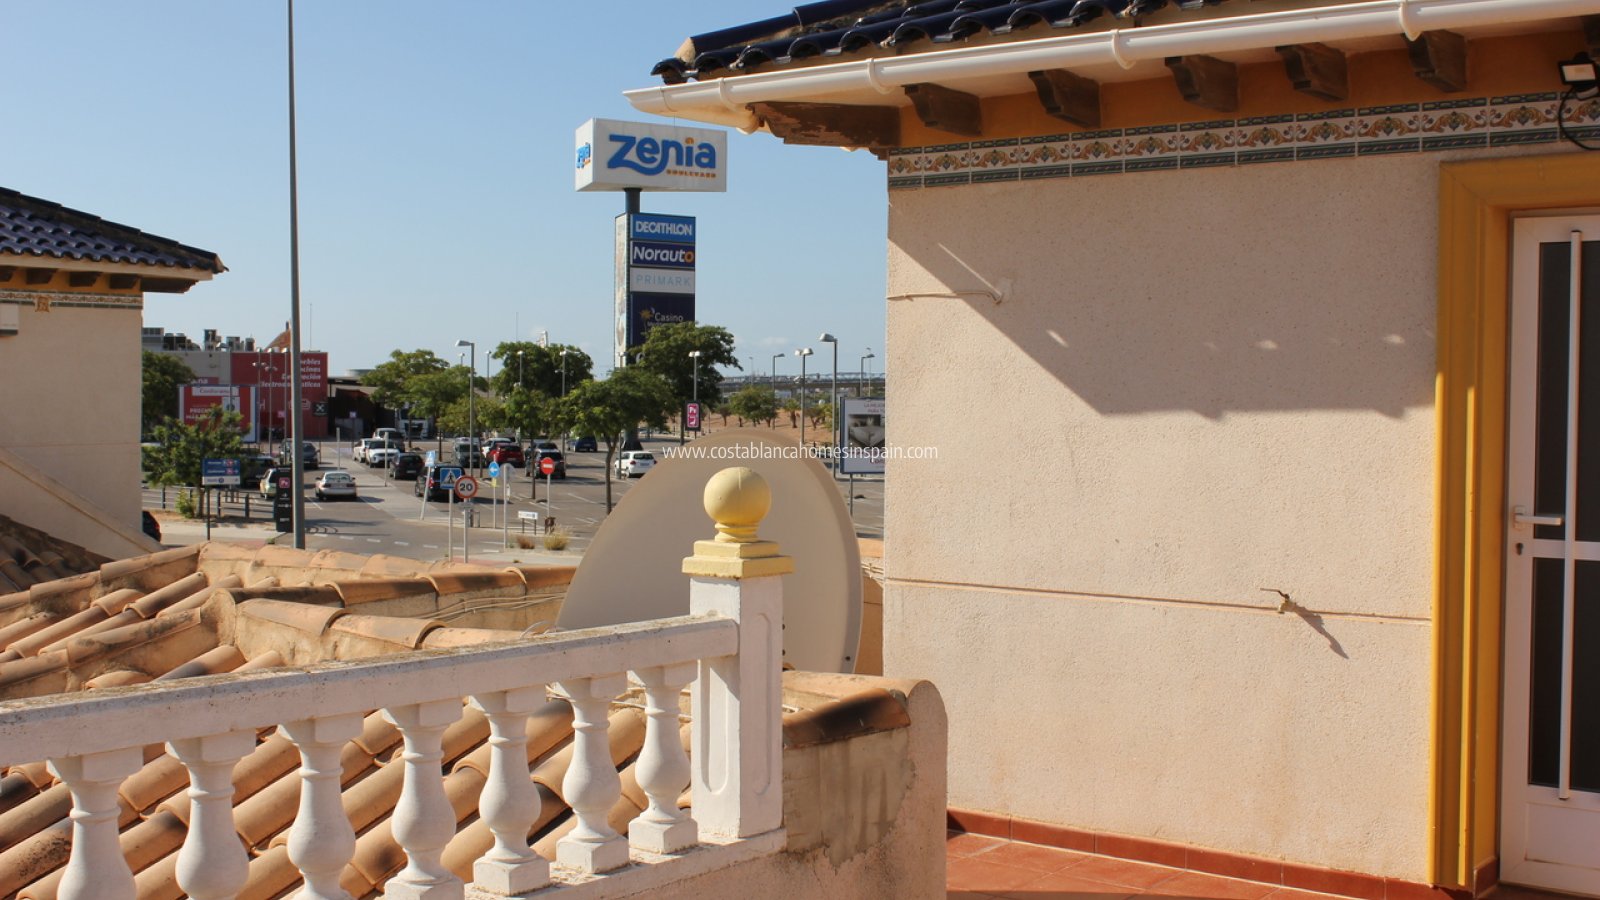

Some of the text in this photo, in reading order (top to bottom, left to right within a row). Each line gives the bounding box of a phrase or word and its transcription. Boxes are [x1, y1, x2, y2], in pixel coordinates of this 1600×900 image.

[635, 221, 692, 236] DECATHLON
[633, 246, 694, 263] Norauto
[636, 274, 691, 287] PRIMARK
[654, 312, 684, 322] Casino
[460, 483, 473, 492] 20
